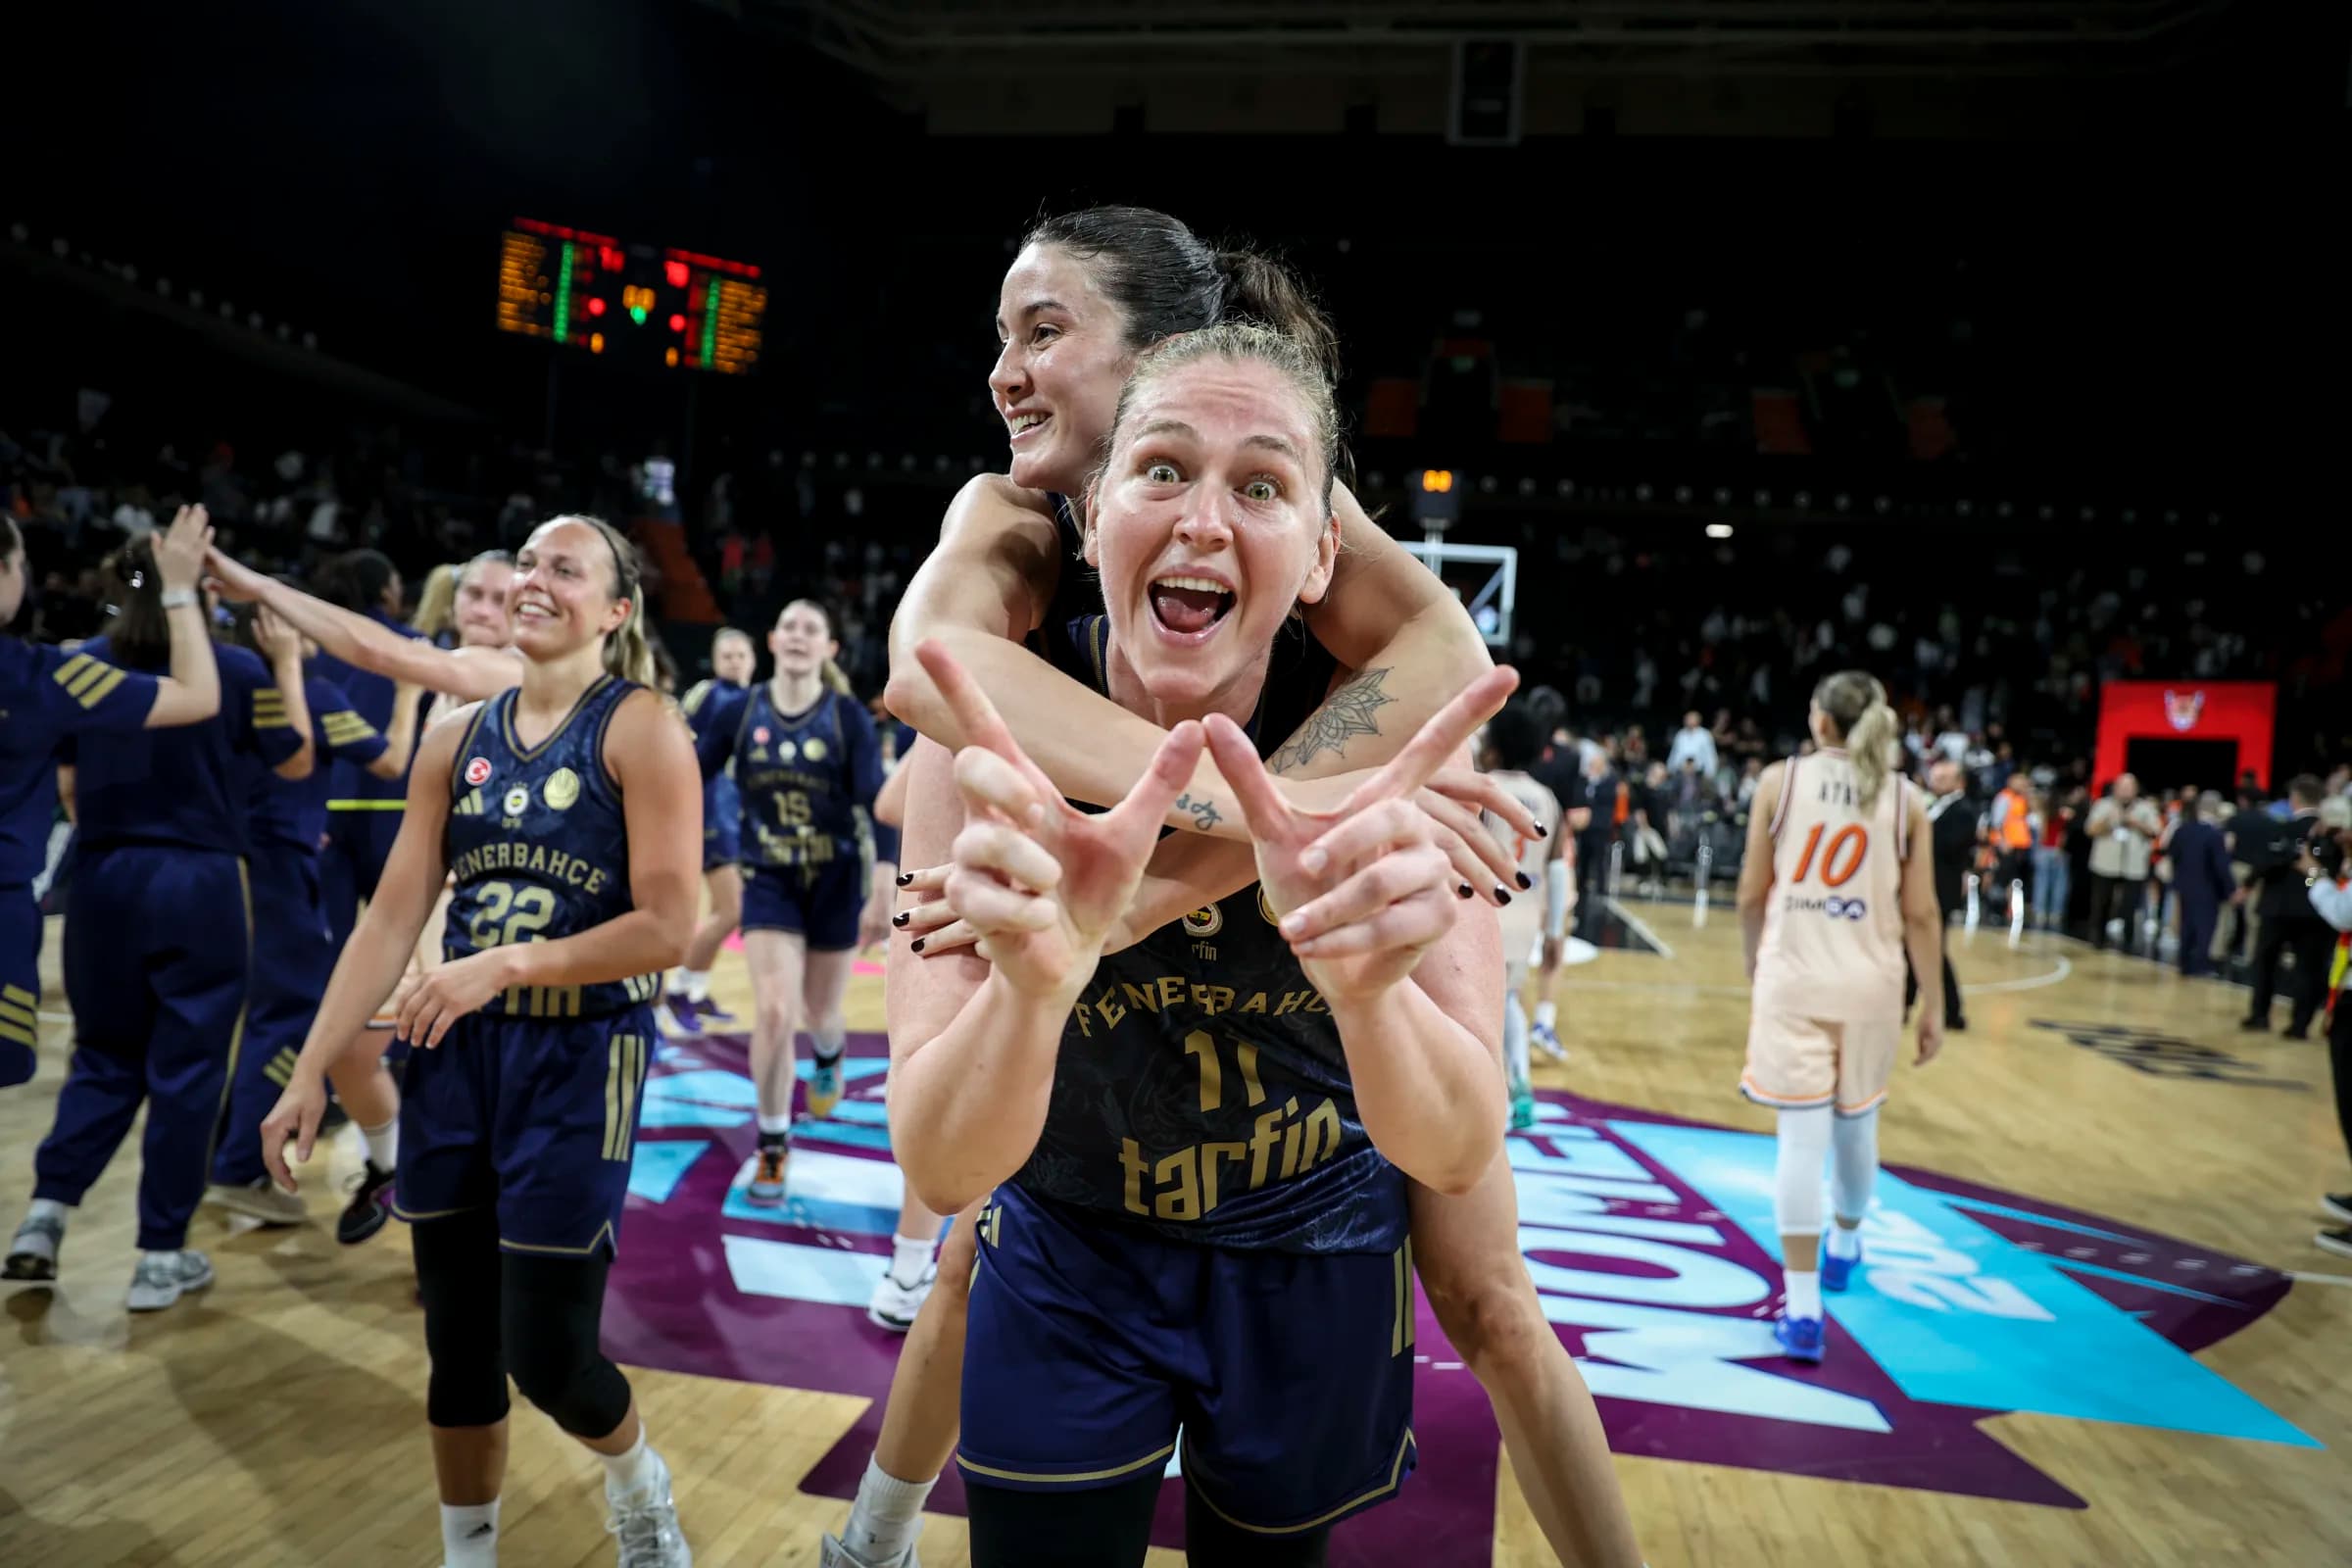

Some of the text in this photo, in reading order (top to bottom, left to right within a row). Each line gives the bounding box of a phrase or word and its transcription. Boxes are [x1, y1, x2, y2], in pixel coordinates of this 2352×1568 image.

[1791, 821, 1868, 888] 10
[469, 881, 557, 948] 22
[1184, 1029, 1266, 1113] 11
[1118, 1096, 1342, 1221] tarfin
